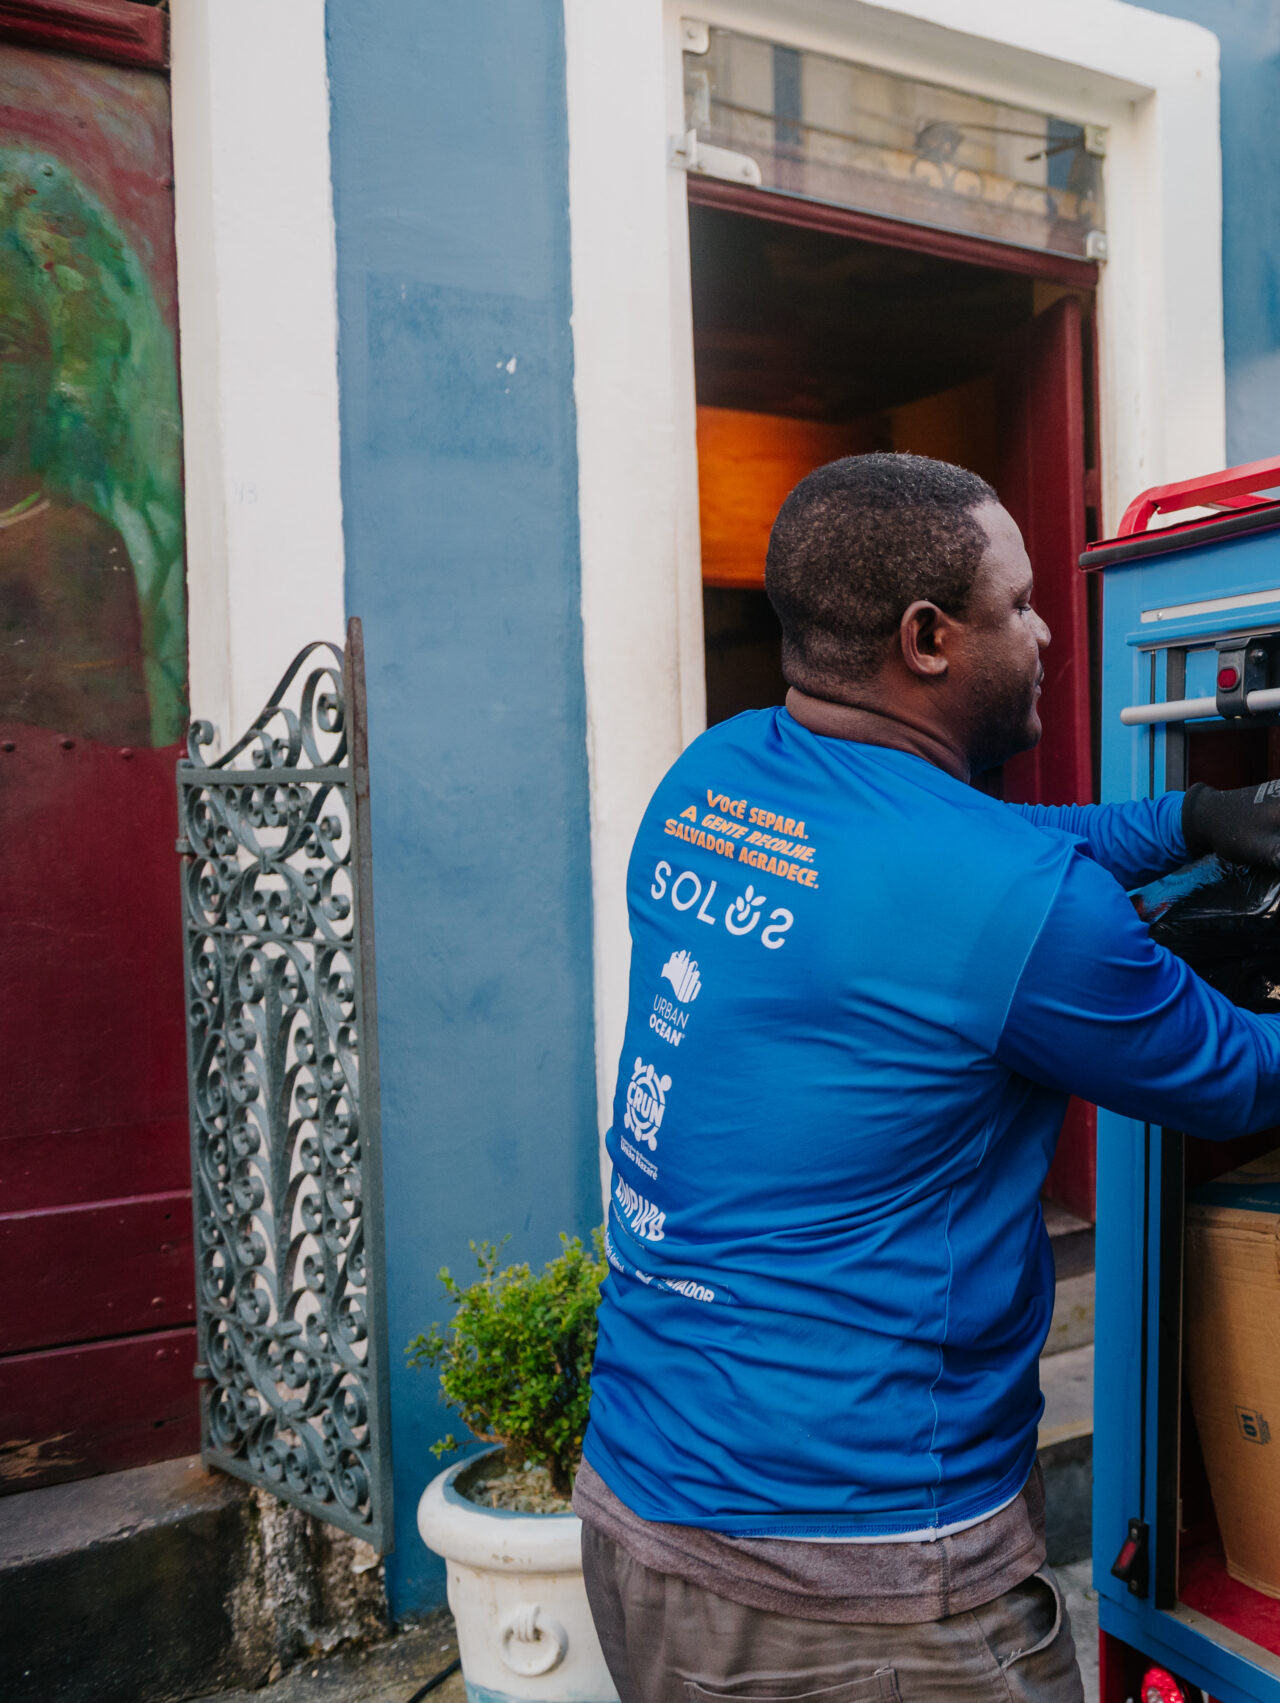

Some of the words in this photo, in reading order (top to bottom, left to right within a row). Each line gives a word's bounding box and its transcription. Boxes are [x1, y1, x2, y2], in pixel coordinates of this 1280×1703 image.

[680, 805, 697, 822] A
[701, 814, 749, 839] GENTE
[745, 831, 816, 863] RECOLHE.
[707, 789, 748, 819] VOCÊ
[748, 807, 809, 839] SEPARA.
[664, 818, 735, 859] SALVADOR
[738, 846, 819, 889] AGRADECE.
[653, 994, 689, 1029] URBAN
[626, 1081, 666, 1128] CRUN
